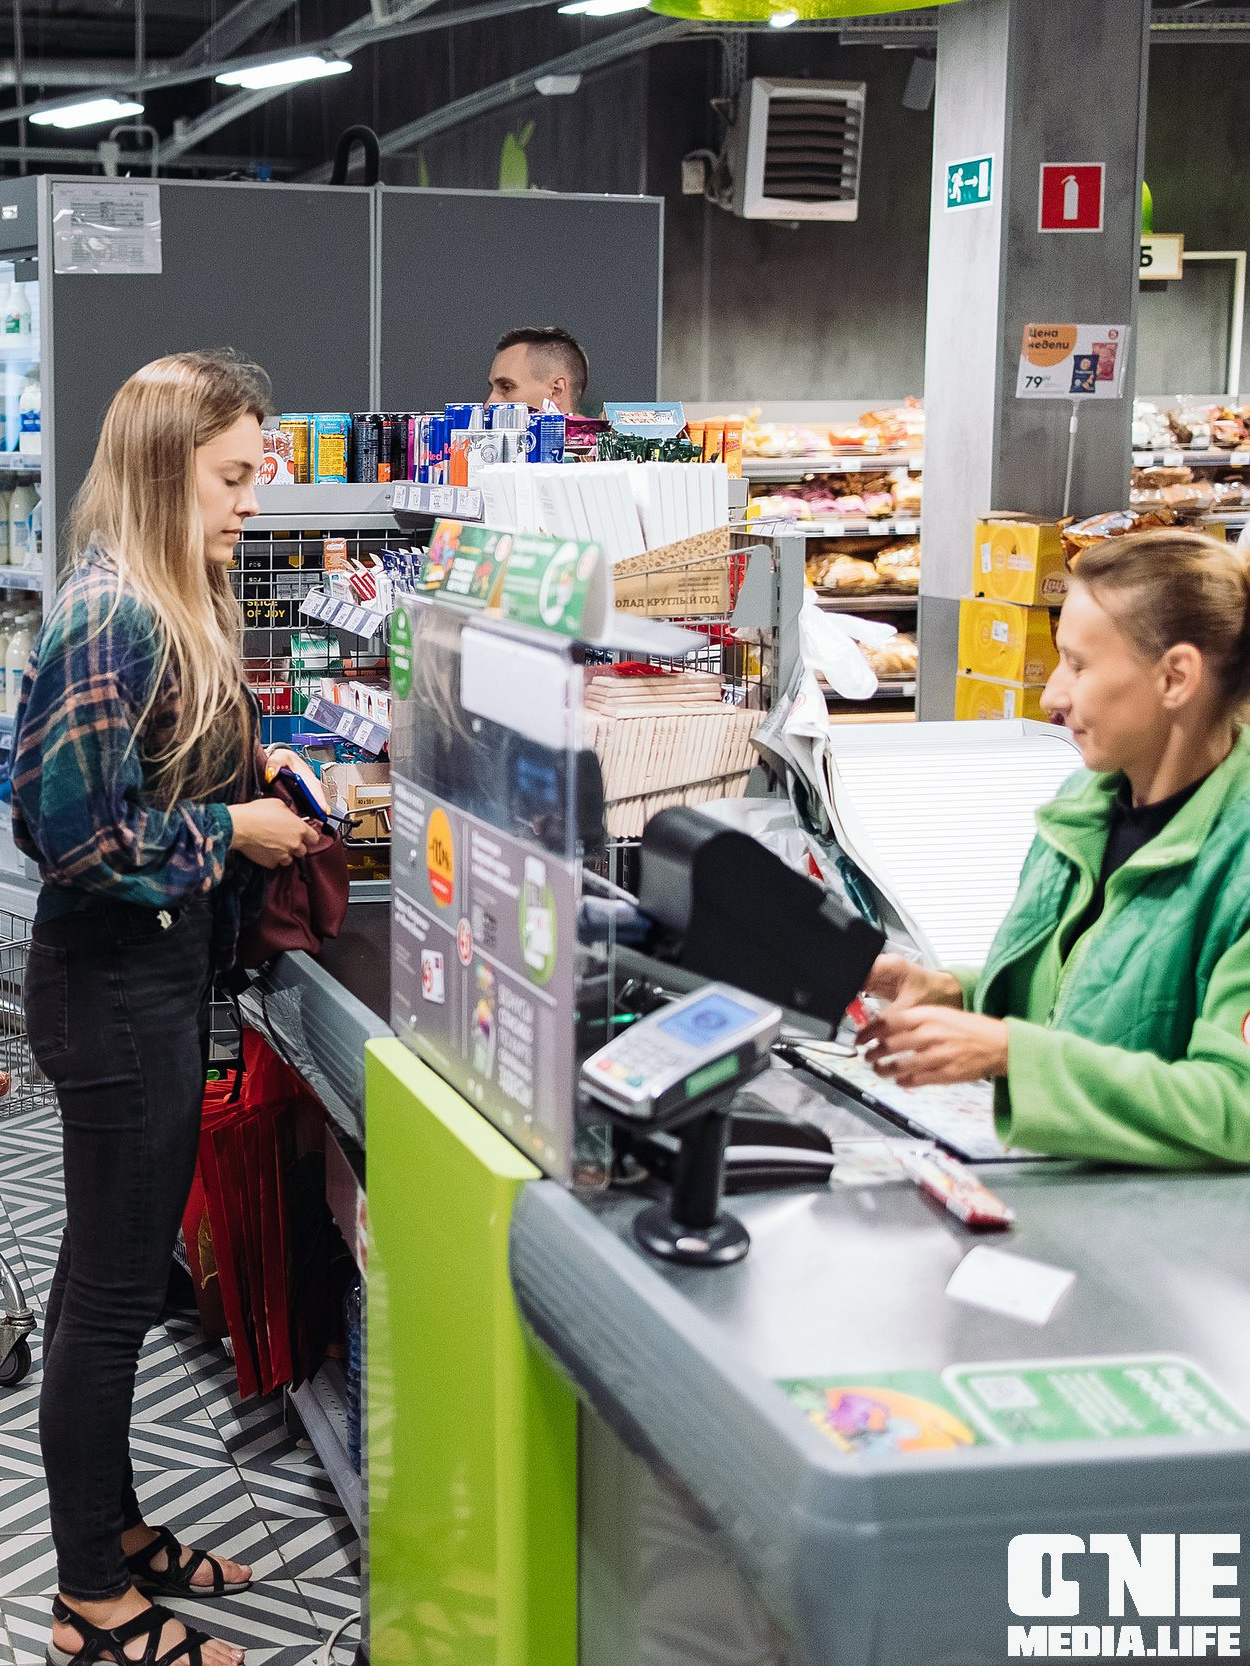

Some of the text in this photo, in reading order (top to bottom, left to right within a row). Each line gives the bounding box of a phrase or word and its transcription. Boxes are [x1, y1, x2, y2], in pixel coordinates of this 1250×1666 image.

[1029, 329, 1058, 338] Цена
[1025, 376, 1043, 389] 79
[615, 595, 719, 608] ОЛАД КРУГЛЫЙ ГОД
[247, 609, 285, 618] OF JOY
